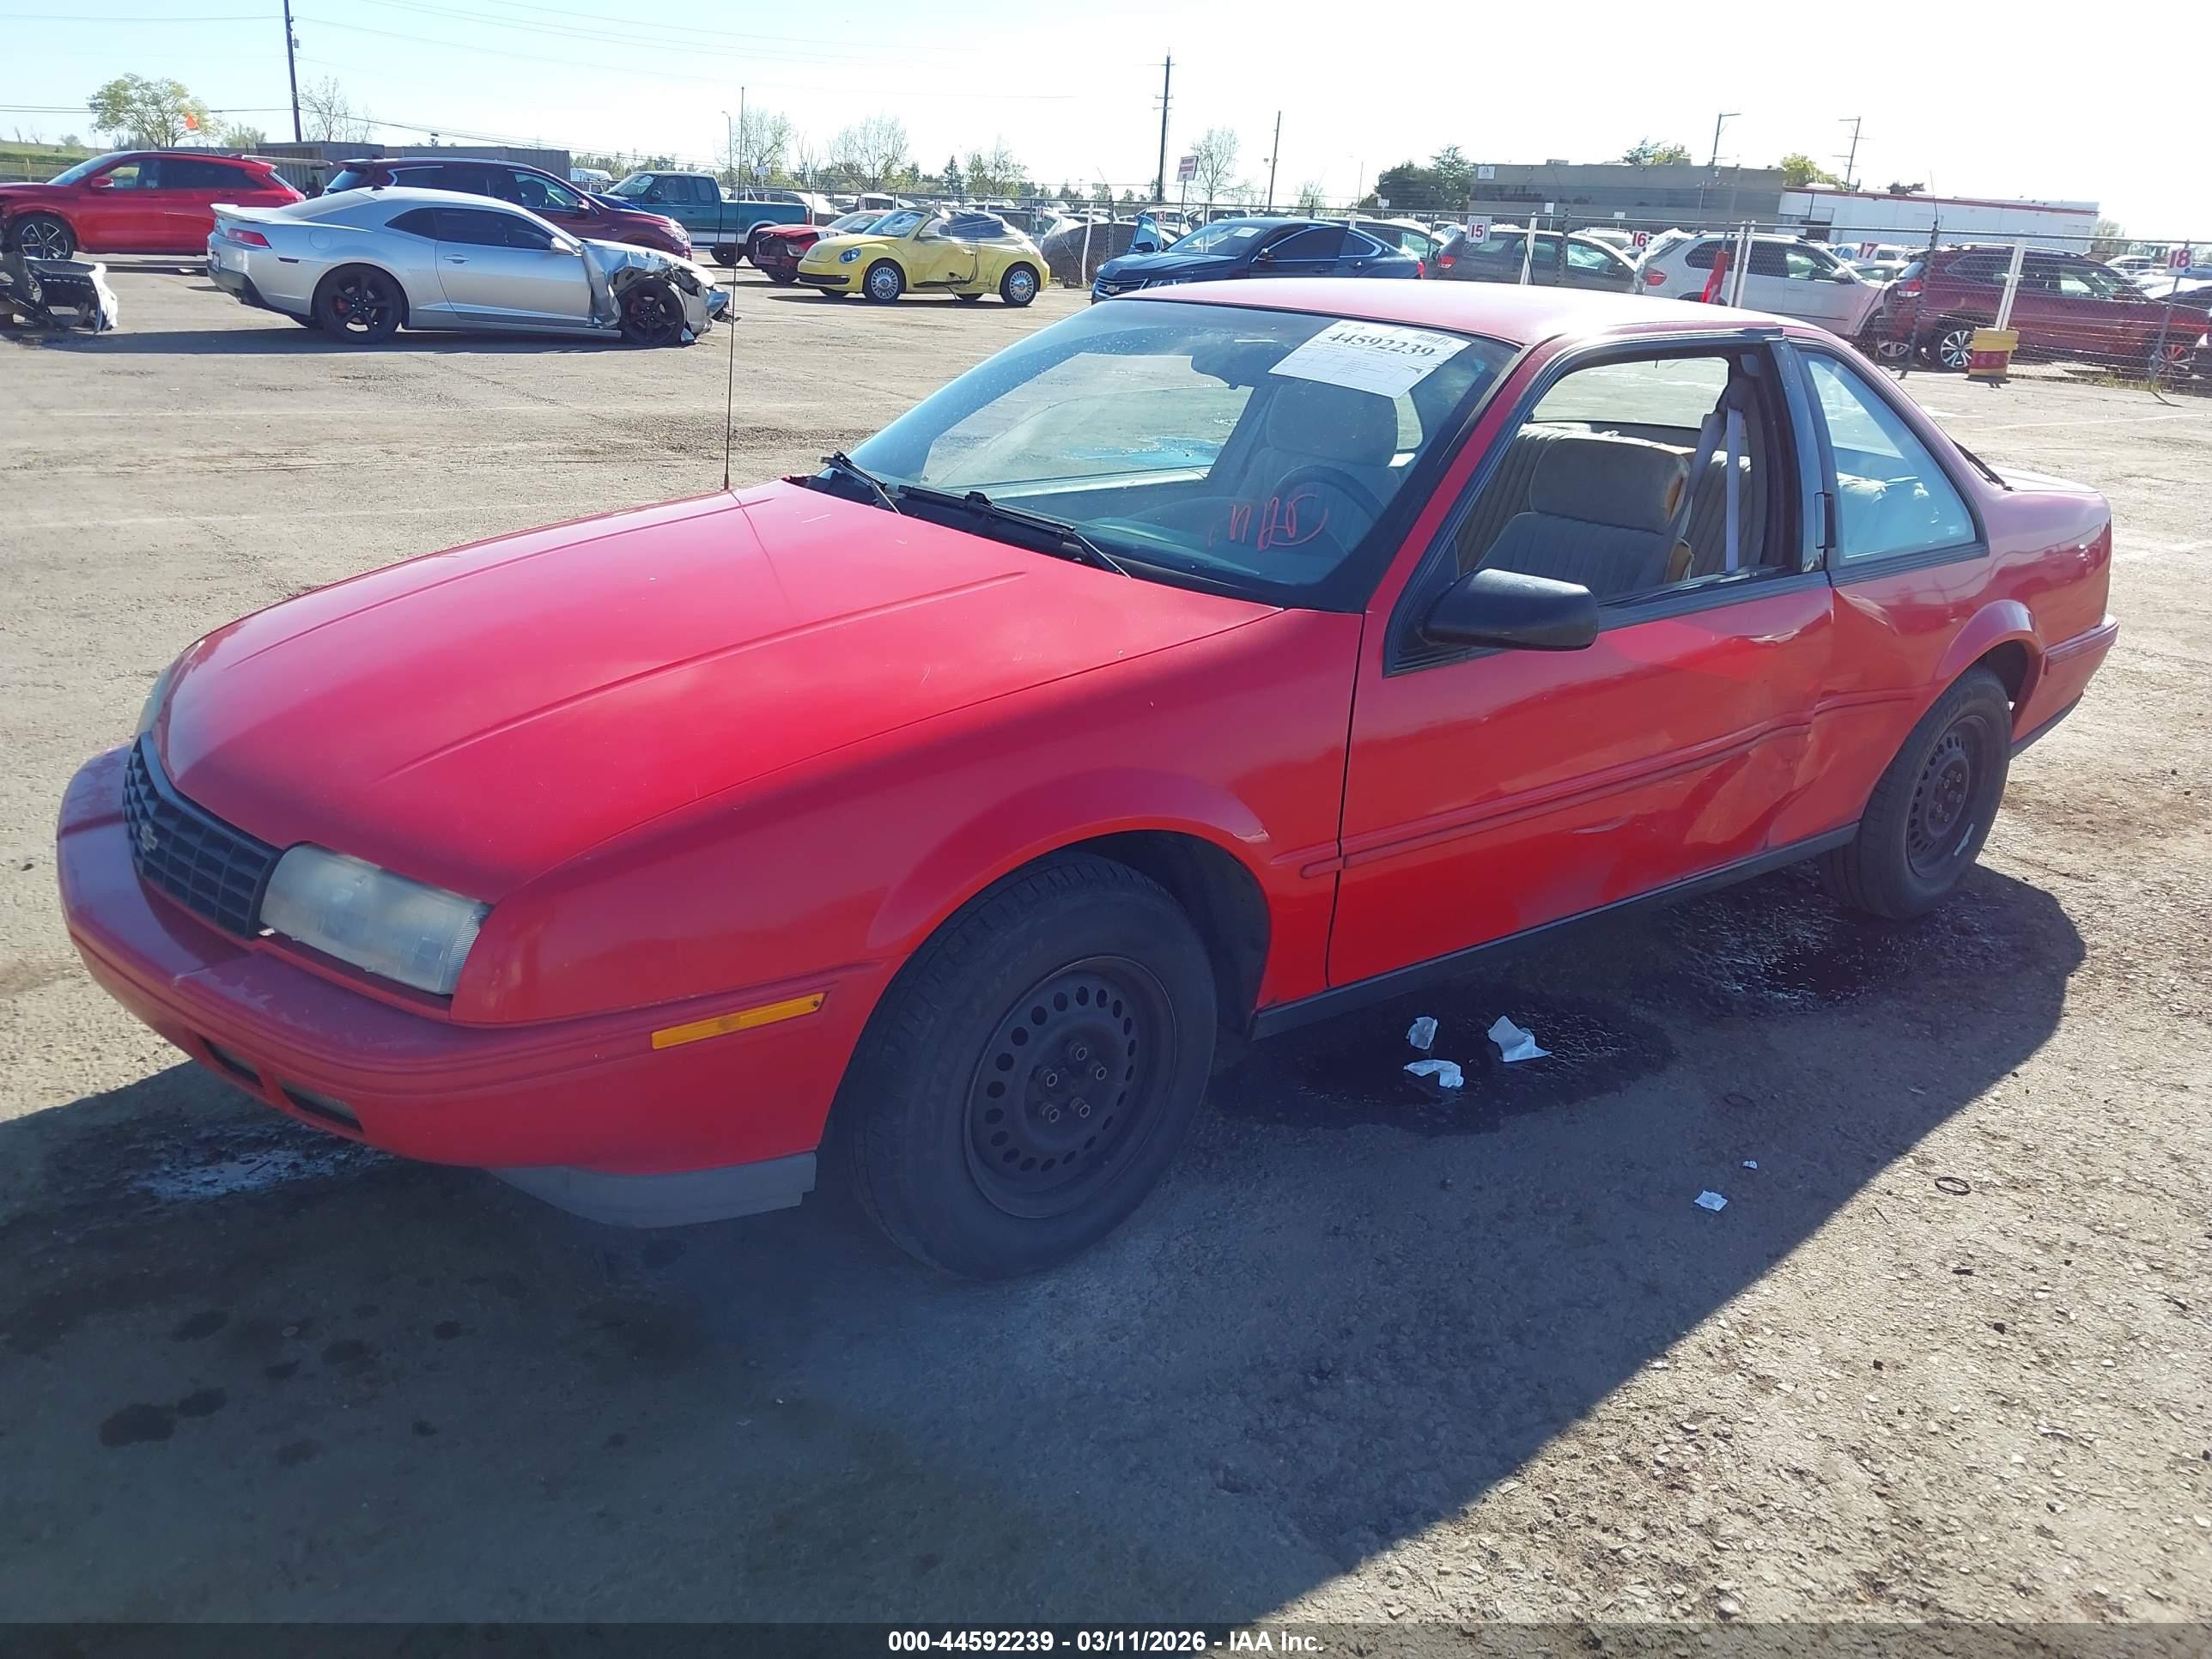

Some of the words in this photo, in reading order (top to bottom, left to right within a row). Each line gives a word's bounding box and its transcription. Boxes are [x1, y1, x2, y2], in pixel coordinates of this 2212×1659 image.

[1158, 210, 1165, 222] 13
[1470, 224, 1484, 238] 15
[1632, 232, 1648, 247] 16
[1858, 242, 1879, 258] 17
[2169, 249, 2192, 269] 18
[1328, 332, 1437, 357] 44592239
